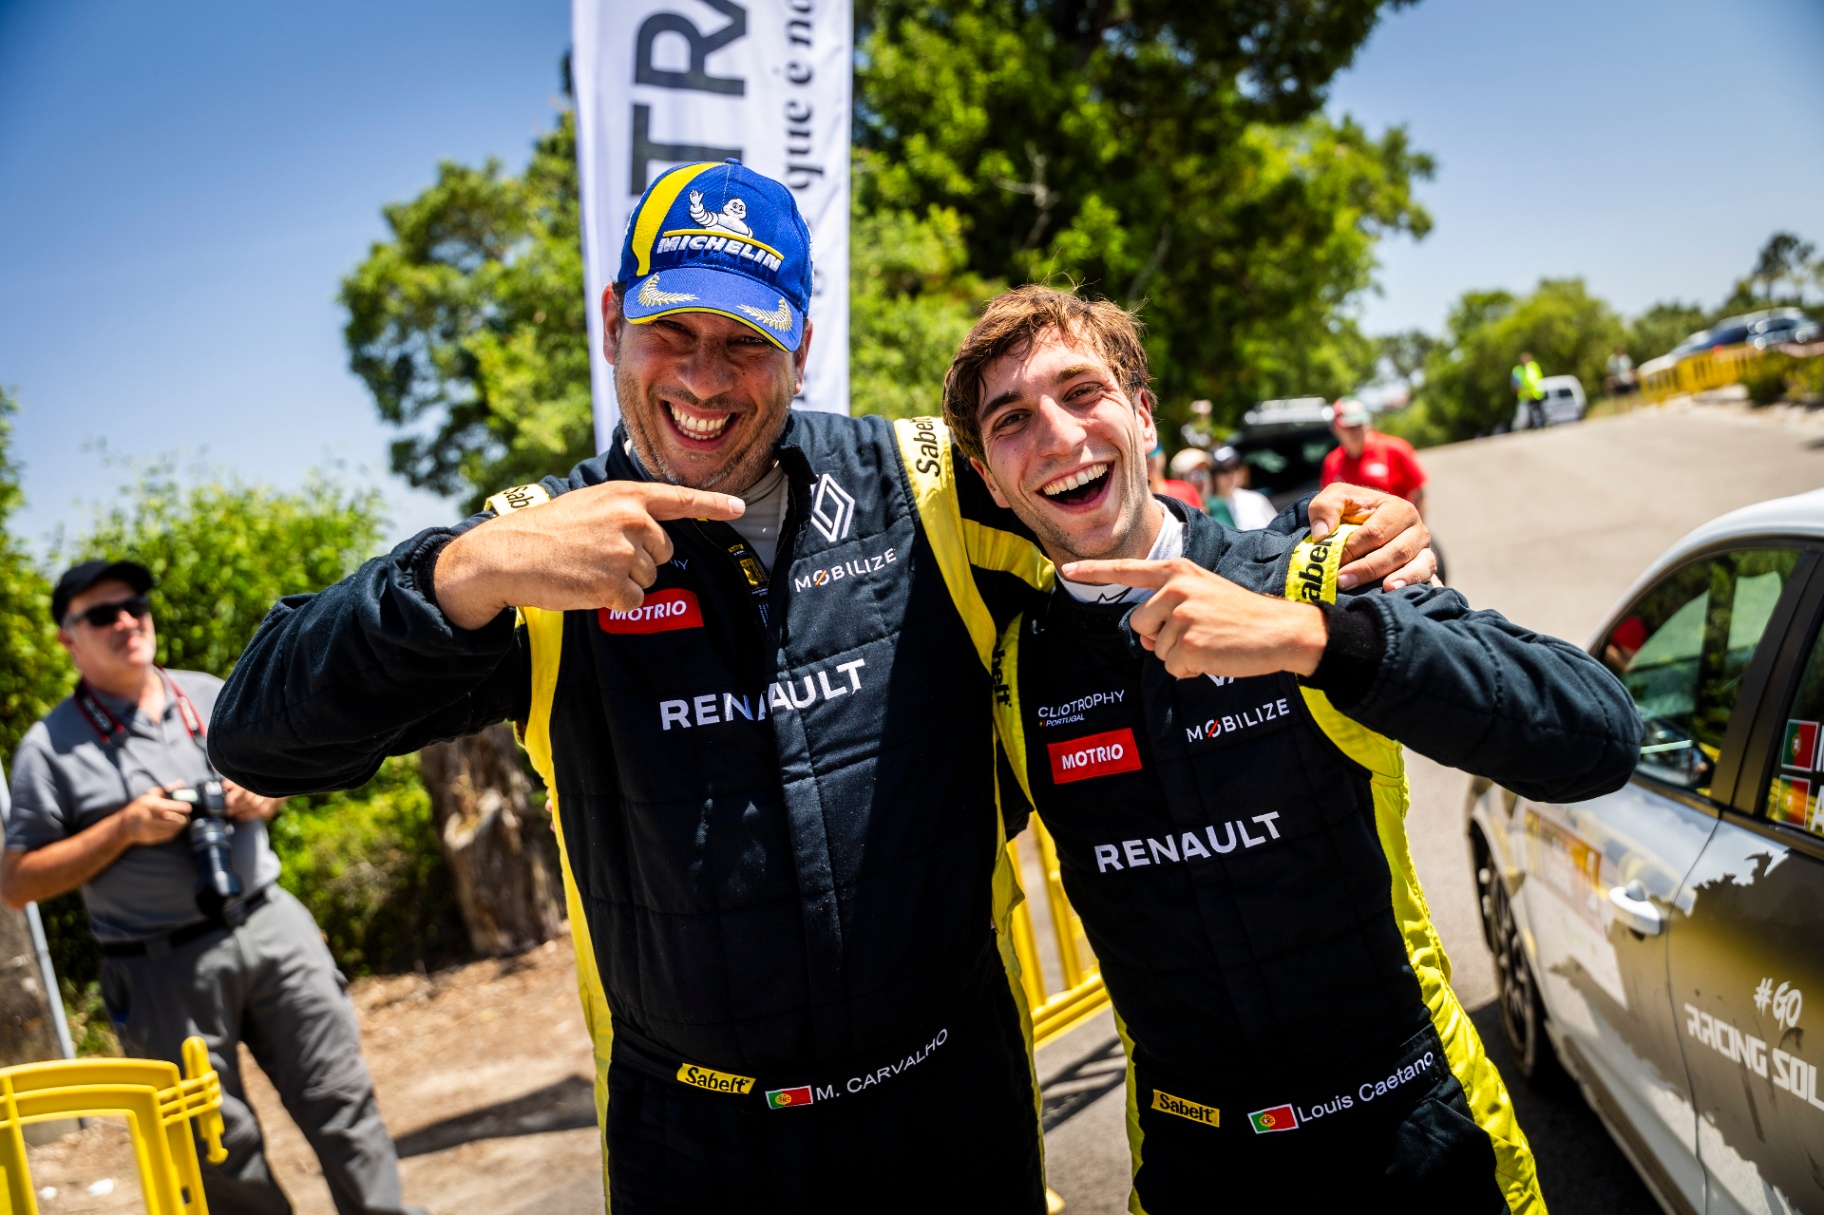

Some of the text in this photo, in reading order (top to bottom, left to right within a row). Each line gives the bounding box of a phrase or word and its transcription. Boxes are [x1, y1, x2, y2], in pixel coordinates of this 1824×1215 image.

[783, 99, 824, 190] que
[656, 234, 782, 272] MICHELIN
[503, 486, 535, 509] Sab
[794, 547, 897, 593] MOBILIZE
[1298, 532, 1339, 602] abel
[609, 600, 688, 621] MOTRIO
[659, 658, 866, 731] RENAULT
[992, 648, 1011, 707] belt
[1037, 689, 1126, 718] CLIOTROPHY
[1045, 712, 1086, 727] PORTUGAL
[1187, 698, 1290, 743] MOBILIZE
[1061, 743, 1124, 770] MOTRIO
[1094, 811, 1282, 874] RENAULT
[1684, 1002, 1769, 1079] RACING
[685, 1066, 749, 1094] Sabelt
[816, 1028, 948, 1101] M. CARVALHO
[1297, 1050, 1434, 1123] Louis Caetano
[1158, 1094, 1215, 1124] Sabelt
